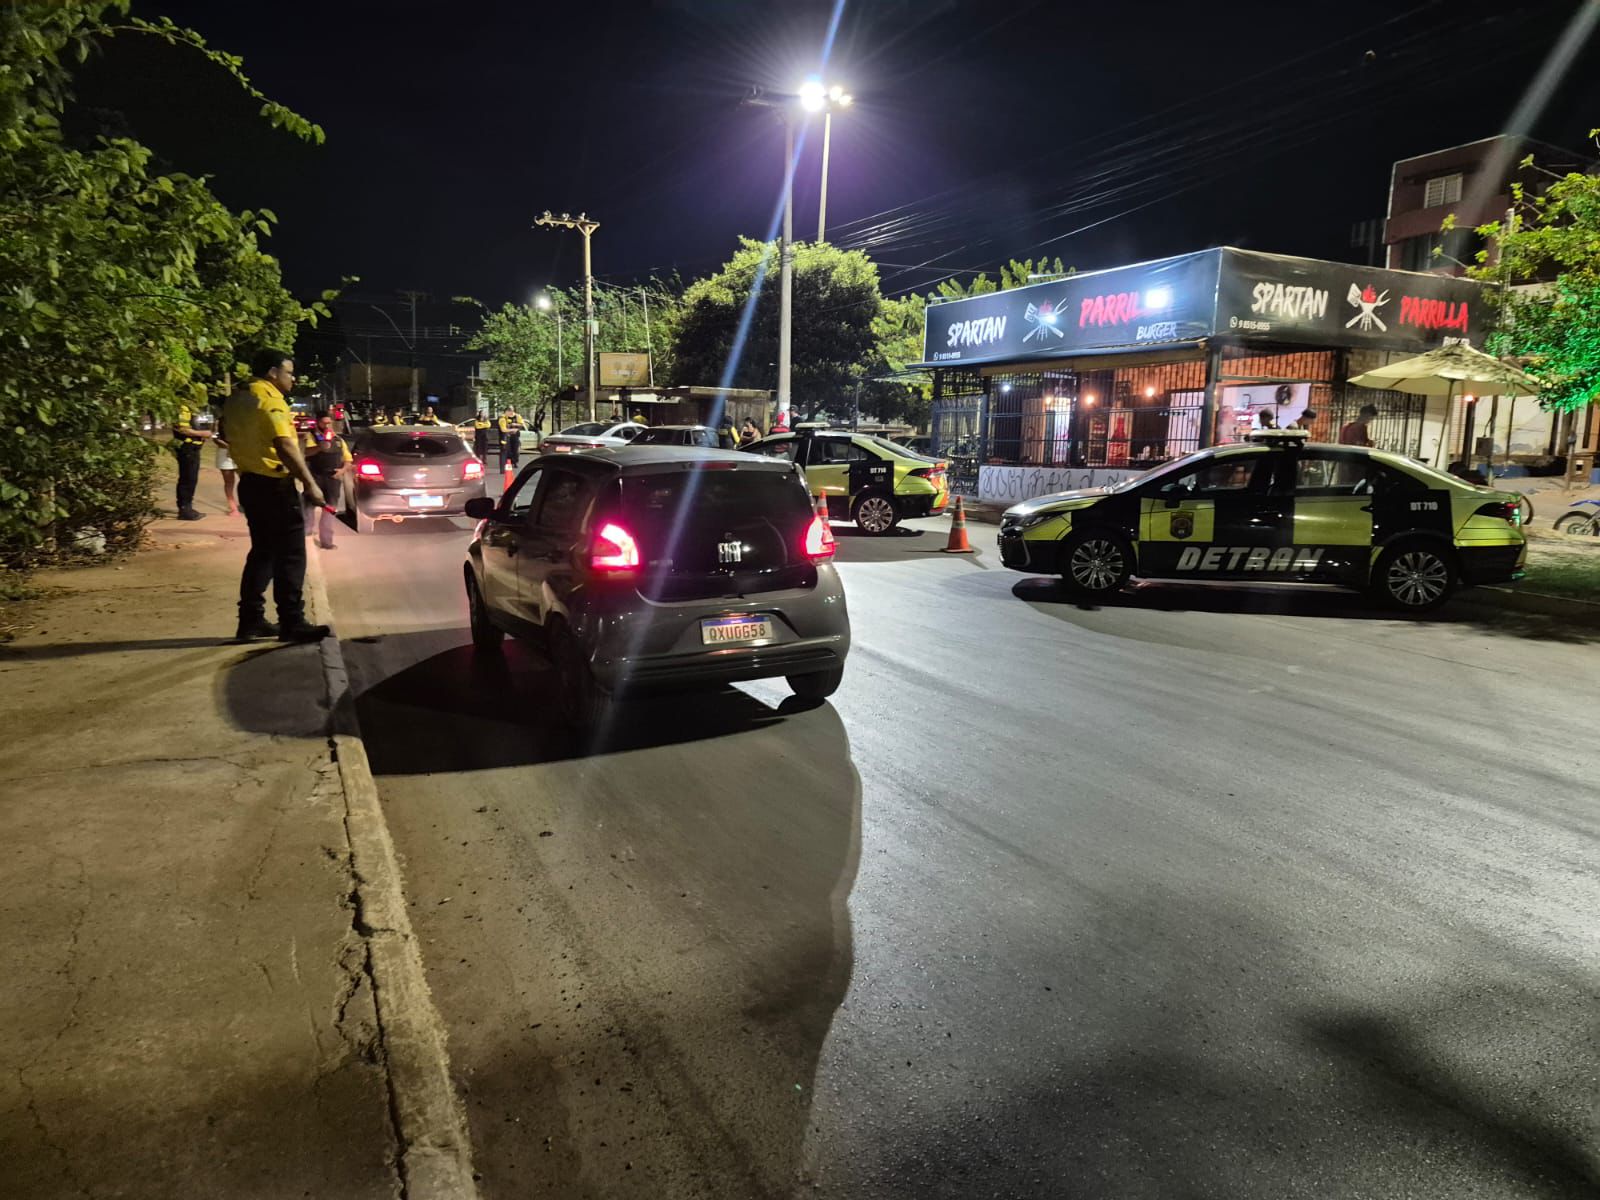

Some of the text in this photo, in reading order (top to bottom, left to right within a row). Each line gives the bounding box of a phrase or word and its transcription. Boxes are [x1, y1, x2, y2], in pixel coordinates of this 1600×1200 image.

[947, 291, 1161, 346] SPARTAN PARRIL
[1252, 282, 1468, 333] SPARTAN PARRILLA
[1136, 322, 1177, 340] BURGER
[1176, 547, 1325, 572] DETRAN
